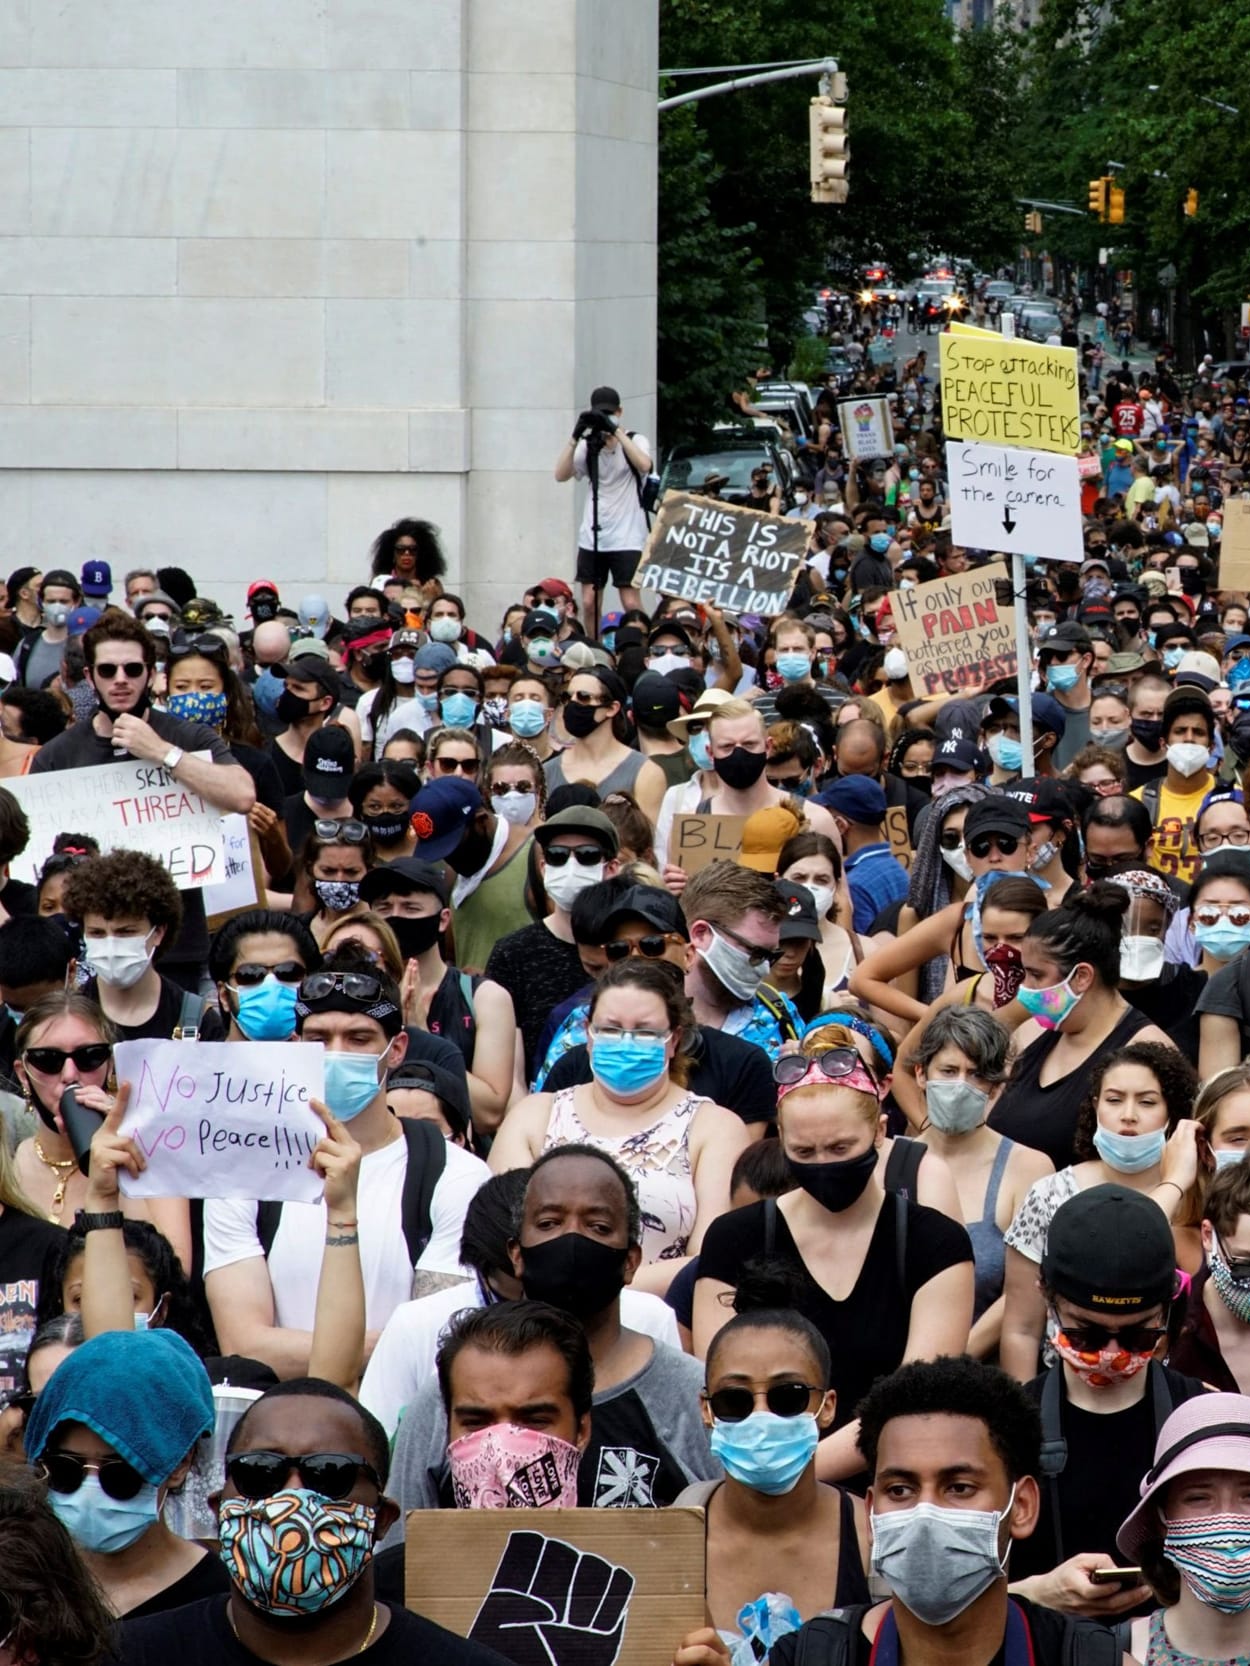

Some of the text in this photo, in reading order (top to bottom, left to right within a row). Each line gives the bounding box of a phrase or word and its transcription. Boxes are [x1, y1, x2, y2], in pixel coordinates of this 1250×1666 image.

[944, 377, 1054, 408] PEACEFUL
[947, 406, 1081, 449] PROTESTERS
[1119, 409, 1136, 426] 25
[961, 449, 1056, 482] Smile for
[960, 486, 1066, 508] the camera
[683, 503, 779, 547] THIS IS
[665, 526, 800, 572] NOT A RIOT
[684, 553, 755, 588] ITS A
[642, 564, 788, 613] REBELLION
[896, 588, 918, 622] If
[925, 582, 962, 612] only
[921, 597, 999, 639] PAIN
[905, 624, 1010, 663] bothered you
[915, 661, 935, 676] as
[936, 652, 975, 673] much
[974, 646, 991, 661] as
[112, 791, 208, 827] THREAT
[532, 1468, 546, 1499] LOVE
[544, 1460, 560, 1491] LOVE
